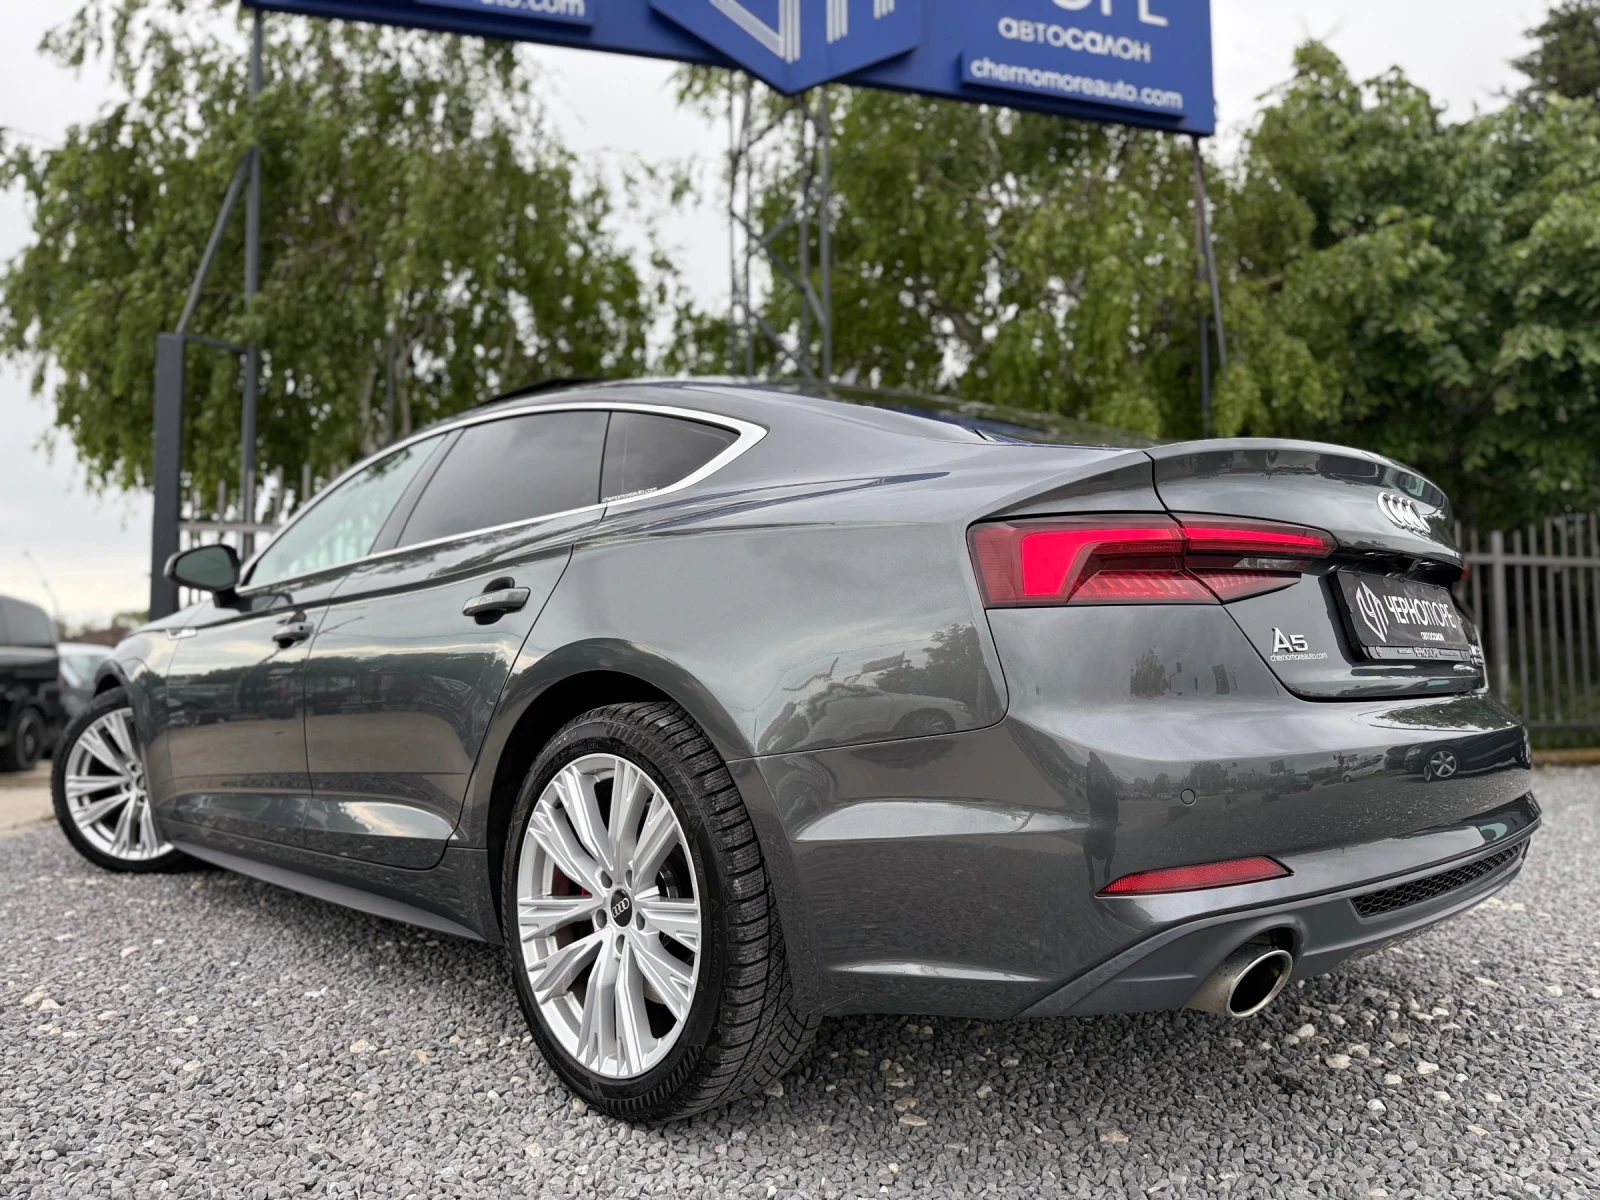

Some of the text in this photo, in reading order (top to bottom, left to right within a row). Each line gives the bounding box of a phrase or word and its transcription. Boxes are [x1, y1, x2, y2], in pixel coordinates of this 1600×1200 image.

[970, 57, 1183, 109] chernomoreauto.com
[1272, 627, 1308, 653] A5
[1270, 652, 1328, 662] chernomoreauto.com
